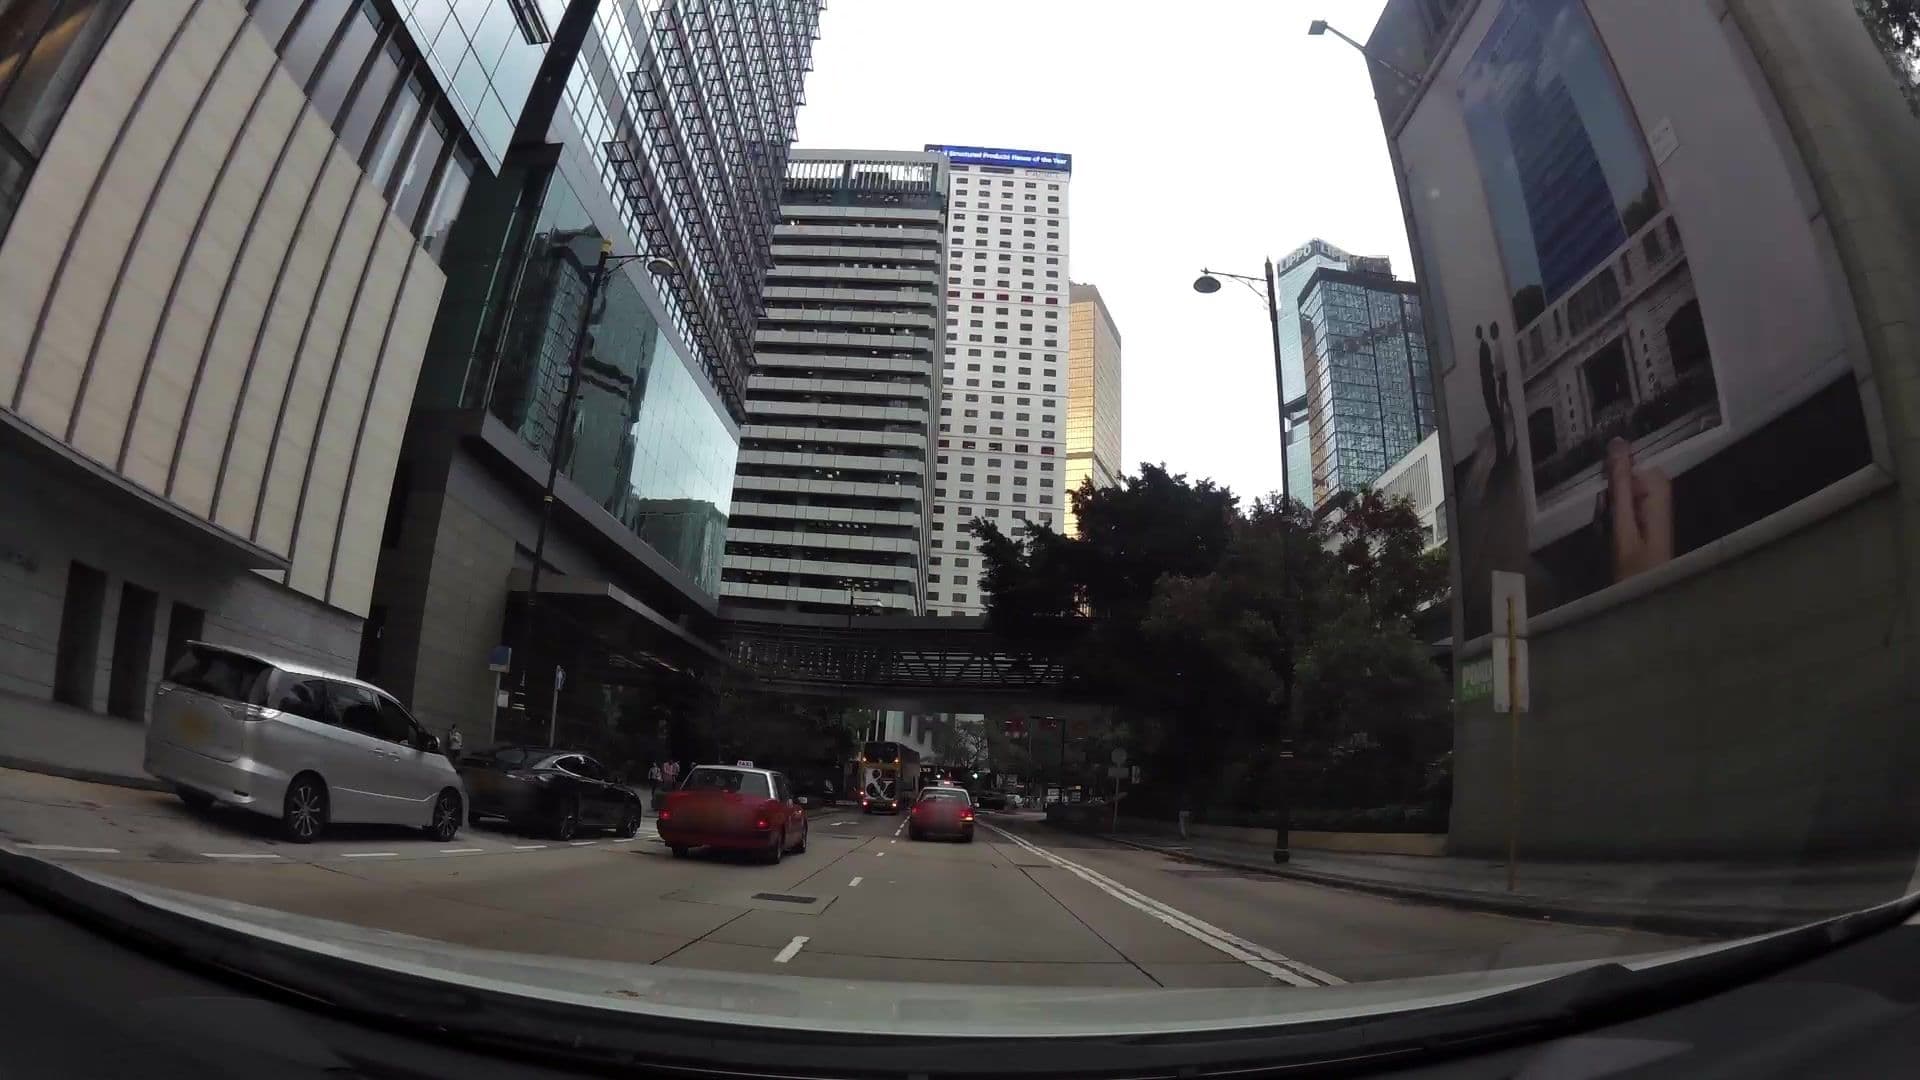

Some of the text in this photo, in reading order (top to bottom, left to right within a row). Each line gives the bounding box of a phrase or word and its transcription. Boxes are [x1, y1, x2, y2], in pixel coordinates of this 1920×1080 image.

[949, 150, 982, 158] Structured
[983, 152, 1011, 160] Products
[1012, 154, 1032, 162] House
[1279, 243, 1312, 273] LIPPO
